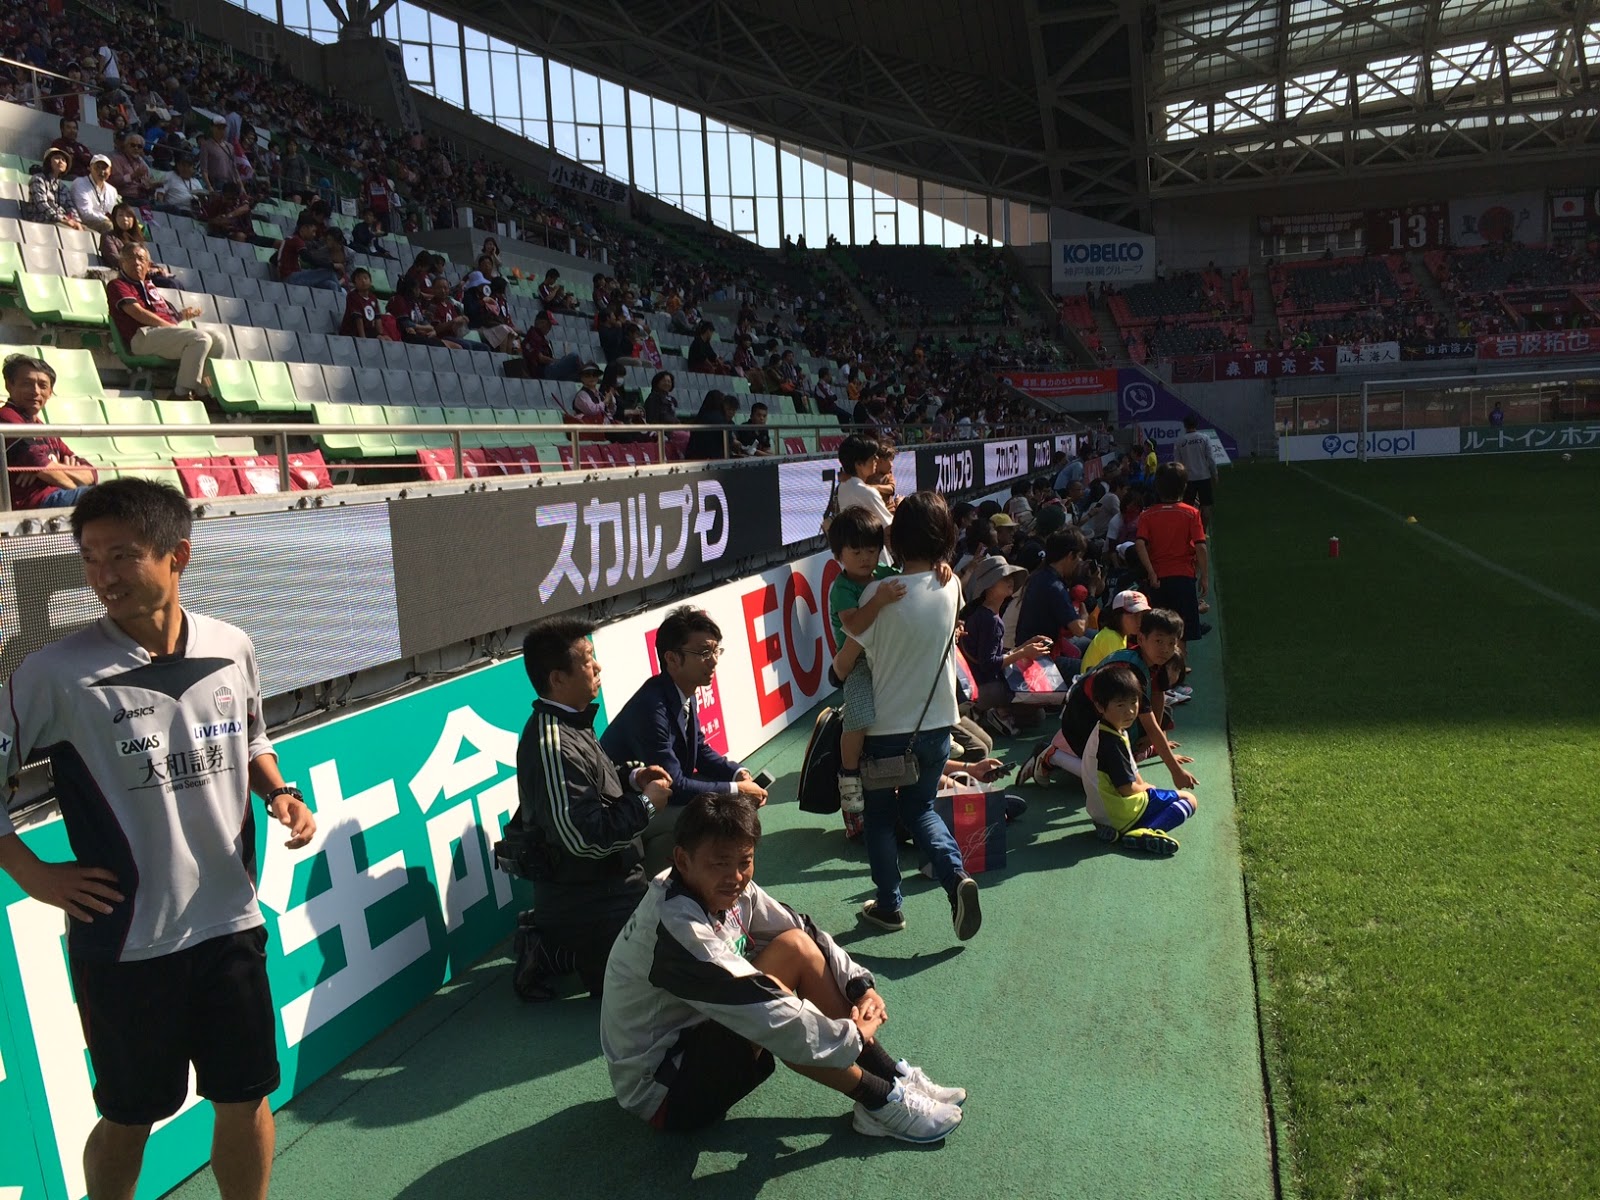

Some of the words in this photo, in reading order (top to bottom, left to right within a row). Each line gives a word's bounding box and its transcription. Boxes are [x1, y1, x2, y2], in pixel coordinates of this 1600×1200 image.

[1388, 214, 1427, 250] 13
[1064, 243, 1144, 263] KOBELCO
[1496, 331, 1590, 356] 岩波拓也
[1226, 357, 1325, 377] 森岡亮太
[1144, 427, 1181, 440] Viber
[121, 735, 159, 755] SAVAS
[139, 744, 224, 784] 大和証券
